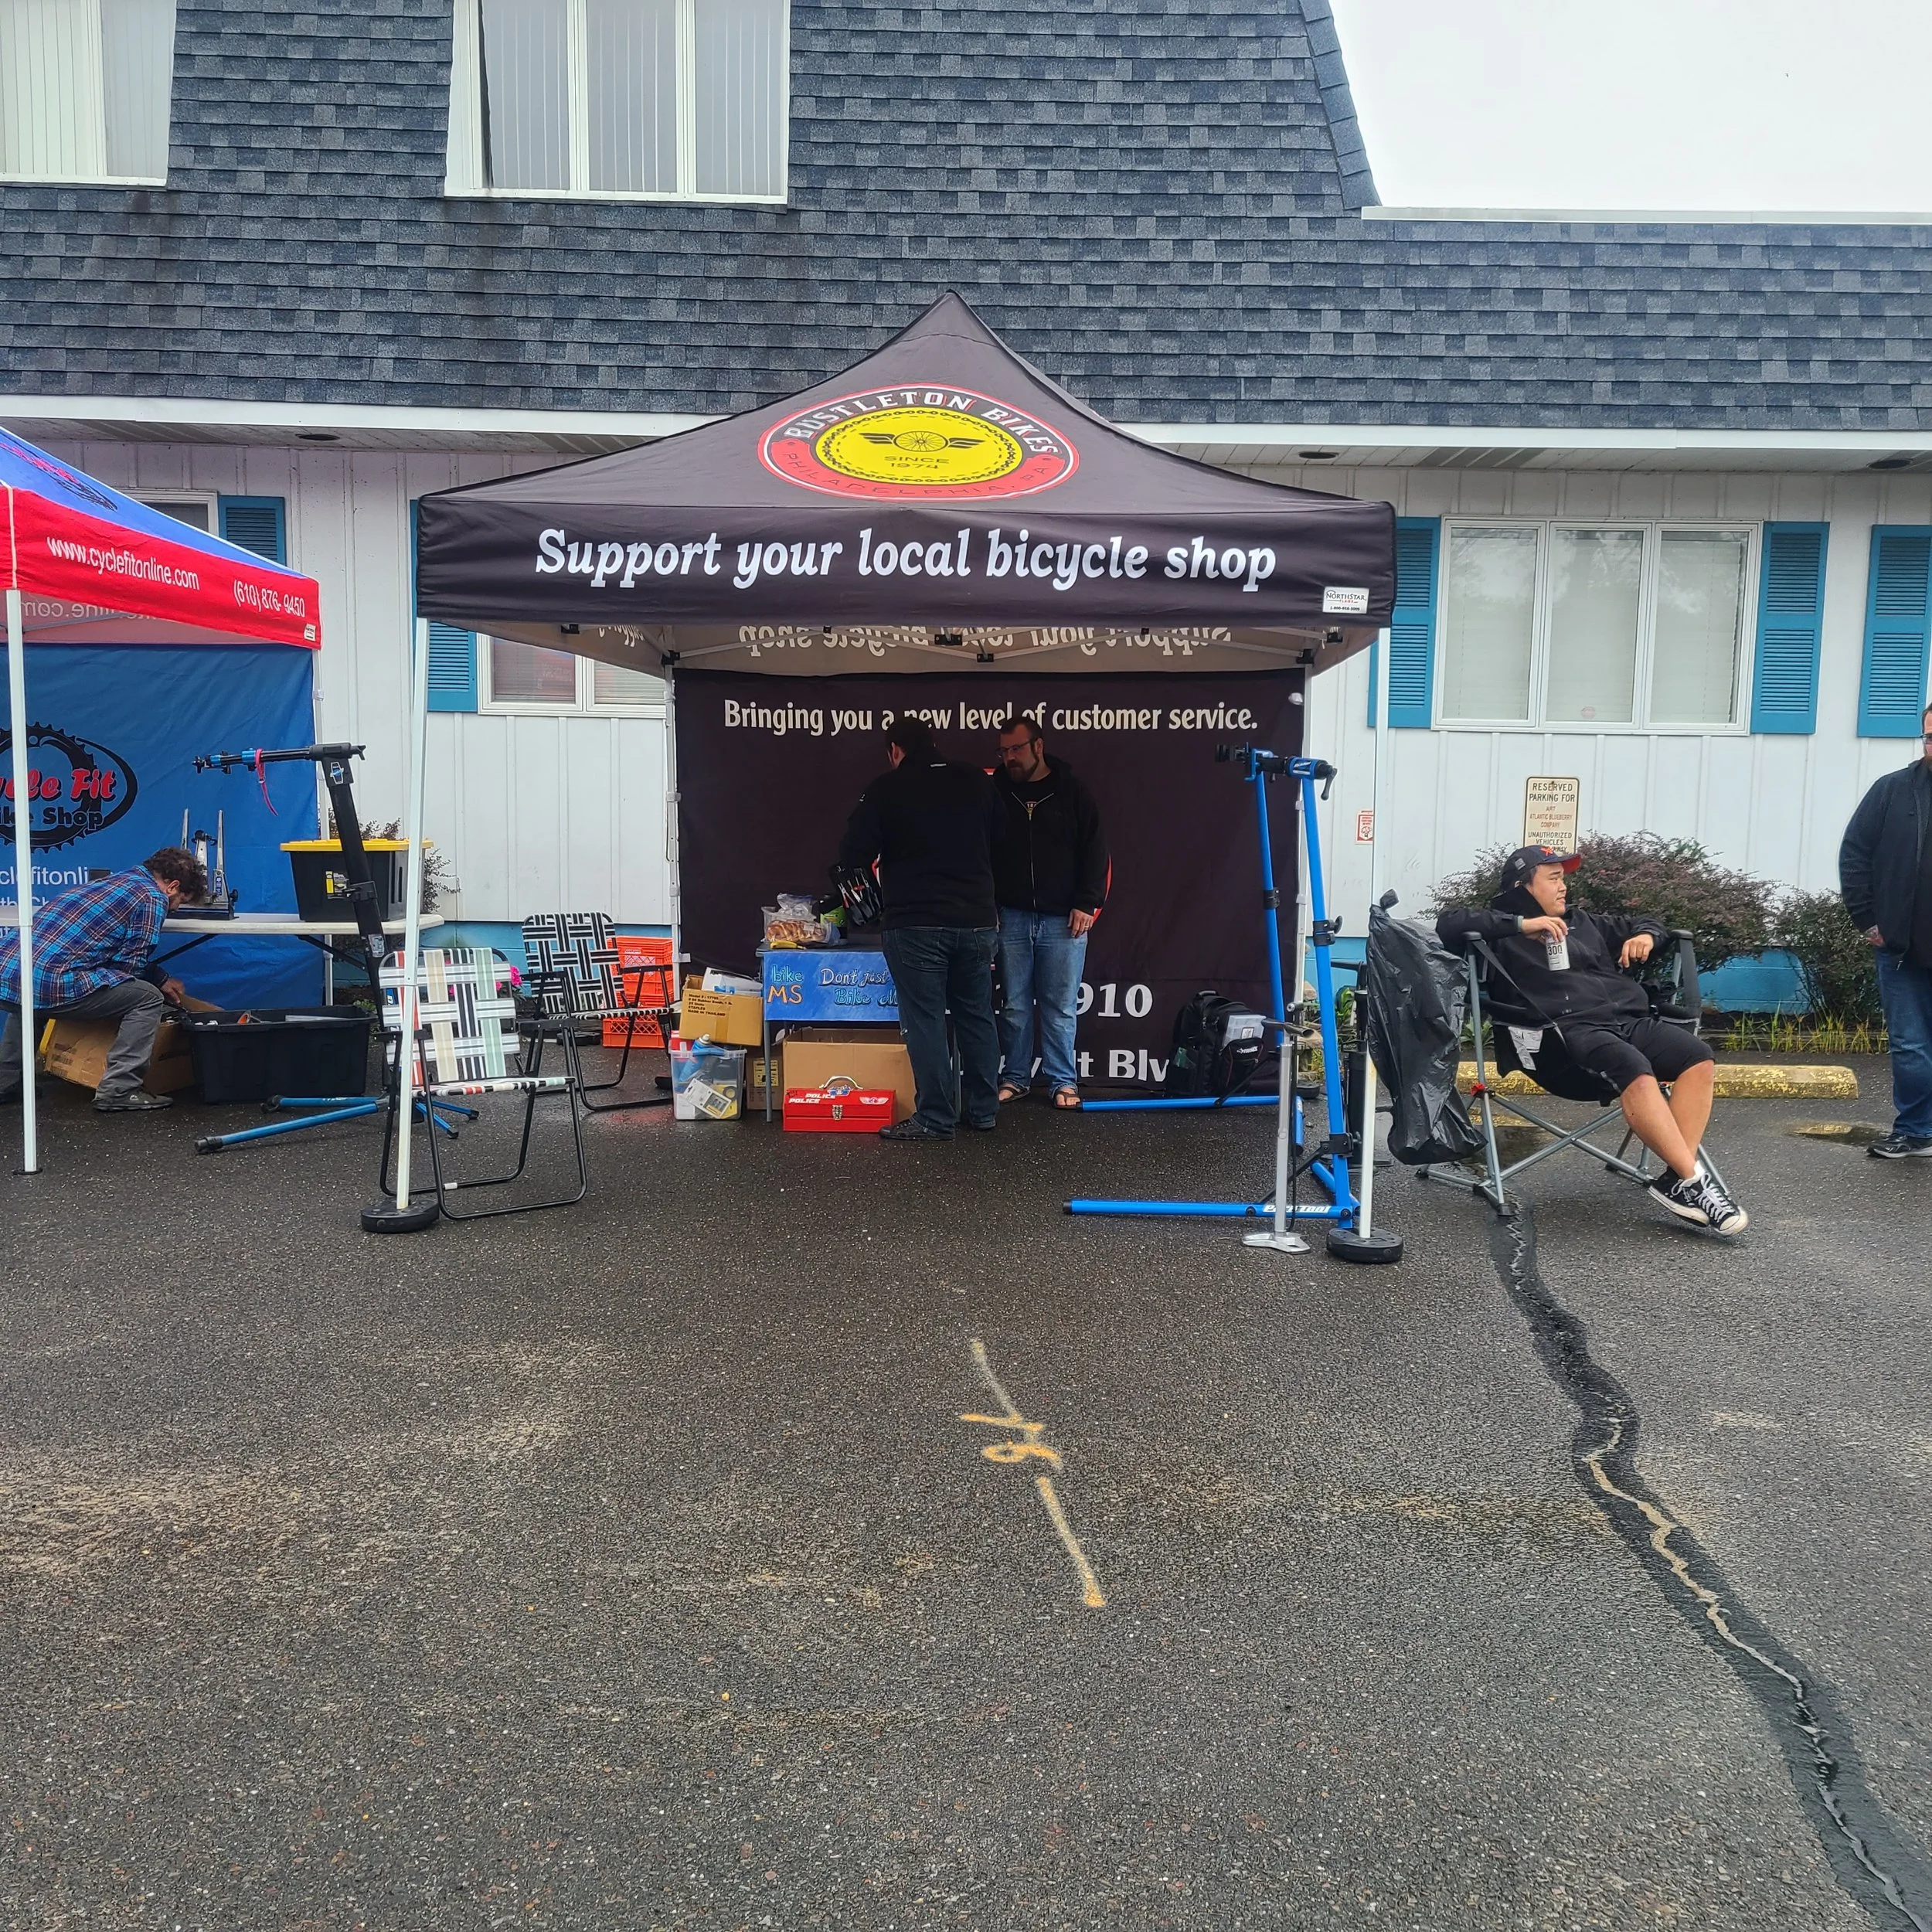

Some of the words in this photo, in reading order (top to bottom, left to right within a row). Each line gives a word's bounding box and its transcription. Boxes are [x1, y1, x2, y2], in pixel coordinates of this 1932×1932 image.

[784, 390, 975, 440] BUSTLETON
[981, 407, 1062, 454] BIKES
[884, 455, 951, 464] SINCE
[46, 536, 200, 591] www.cyclefitonline.com
[535, 528, 722, 588] Support
[733, 541, 843, 590] your
[858, 527, 971, 577] local
[985, 528, 1149, 591] bicycle
[1163, 536, 1277, 592] shop
[233, 579, 261, 612] (610)
[283, 593, 306, 618] 9450
[725, 699, 824, 736] Bringing
[831, 709, 872, 736] you
[959, 702, 1012, 730] level
[1052, 705, 1162, 730] customer
[1168, 702, 1258, 730] service.
[70, 768, 117, 801] Fit
[1532, 783, 1573, 791] RESERVED
[1529, 793, 1559, 802] PARKING
[1561, 794, 1575, 802] FOR
[43, 806, 104, 829] Shop
[772, 964, 804, 983] bike
[859, 970, 889, 988] just
[767, 985, 803, 1004] MS
[835, 988, 872, 1005] Bike
